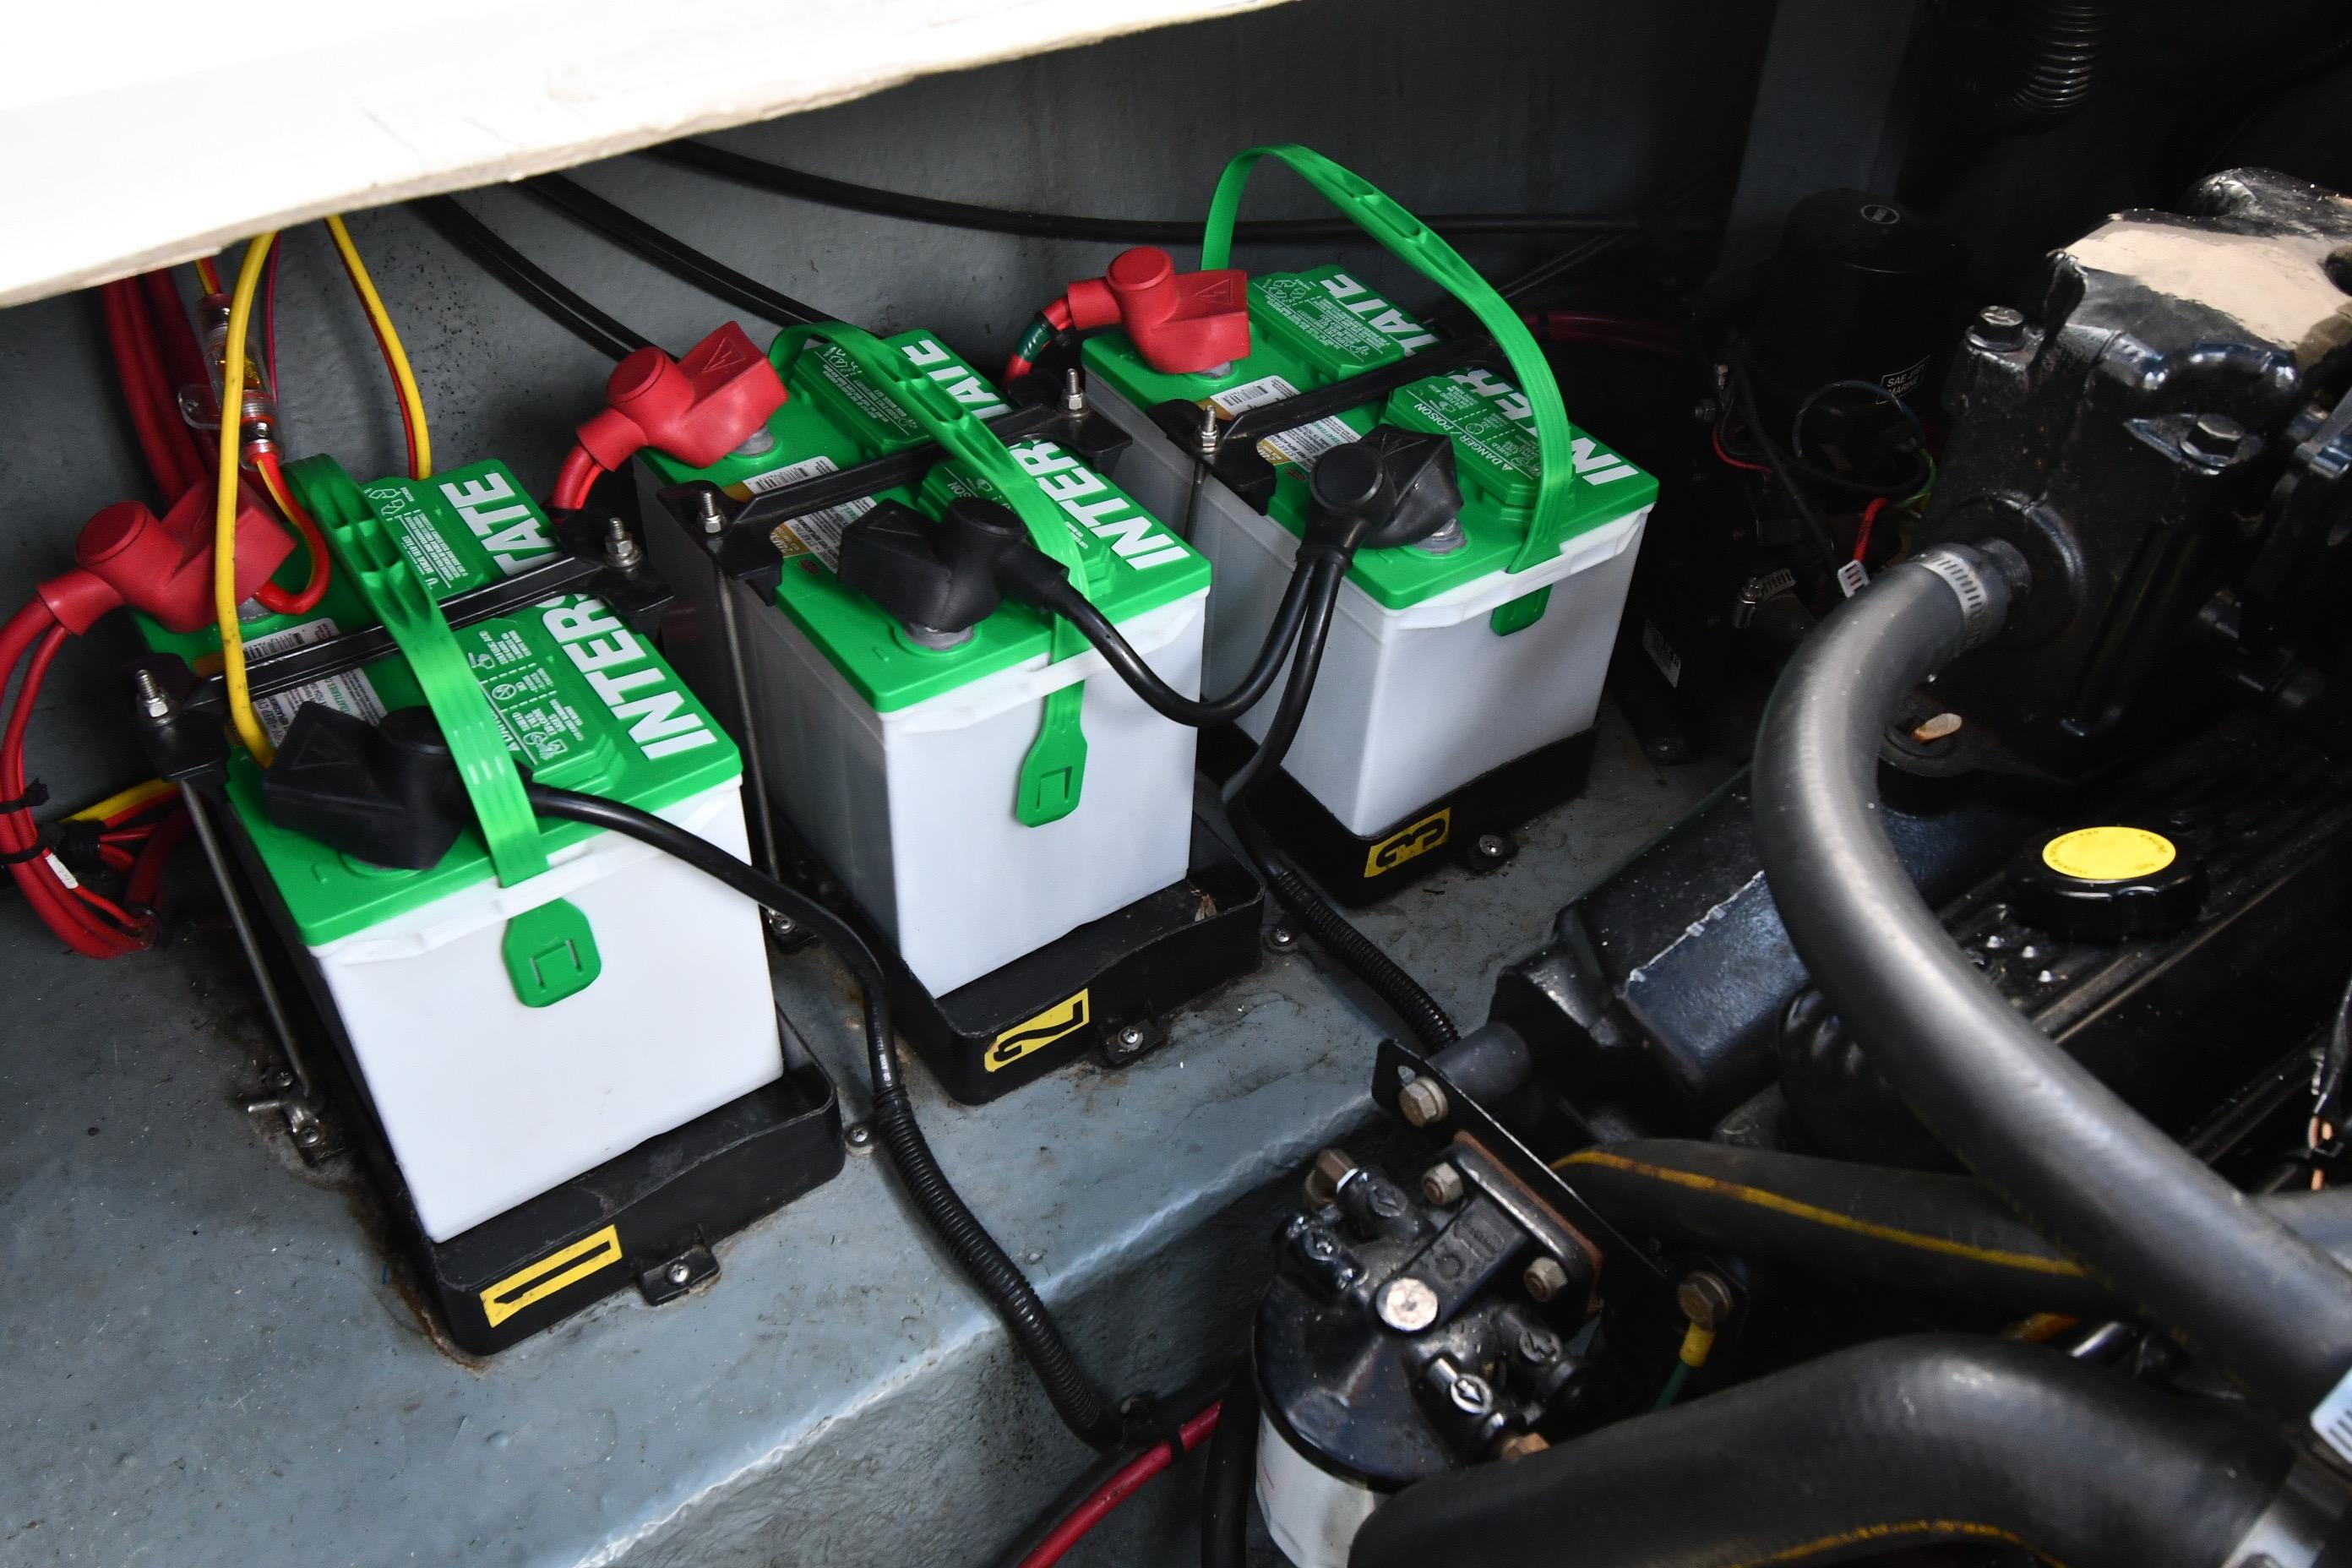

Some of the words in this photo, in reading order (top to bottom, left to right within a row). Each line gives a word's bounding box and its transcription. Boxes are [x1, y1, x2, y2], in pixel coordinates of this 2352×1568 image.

[1886, 373, 1908, 388] SAE
[1412, 401, 1455, 431] POISON
[1456, 433, 1504, 465] DANGER
[1375, 817, 1447, 870] 3
[992, 999, 1083, 1063] 2
[493, 1239, 612, 1305] 1
